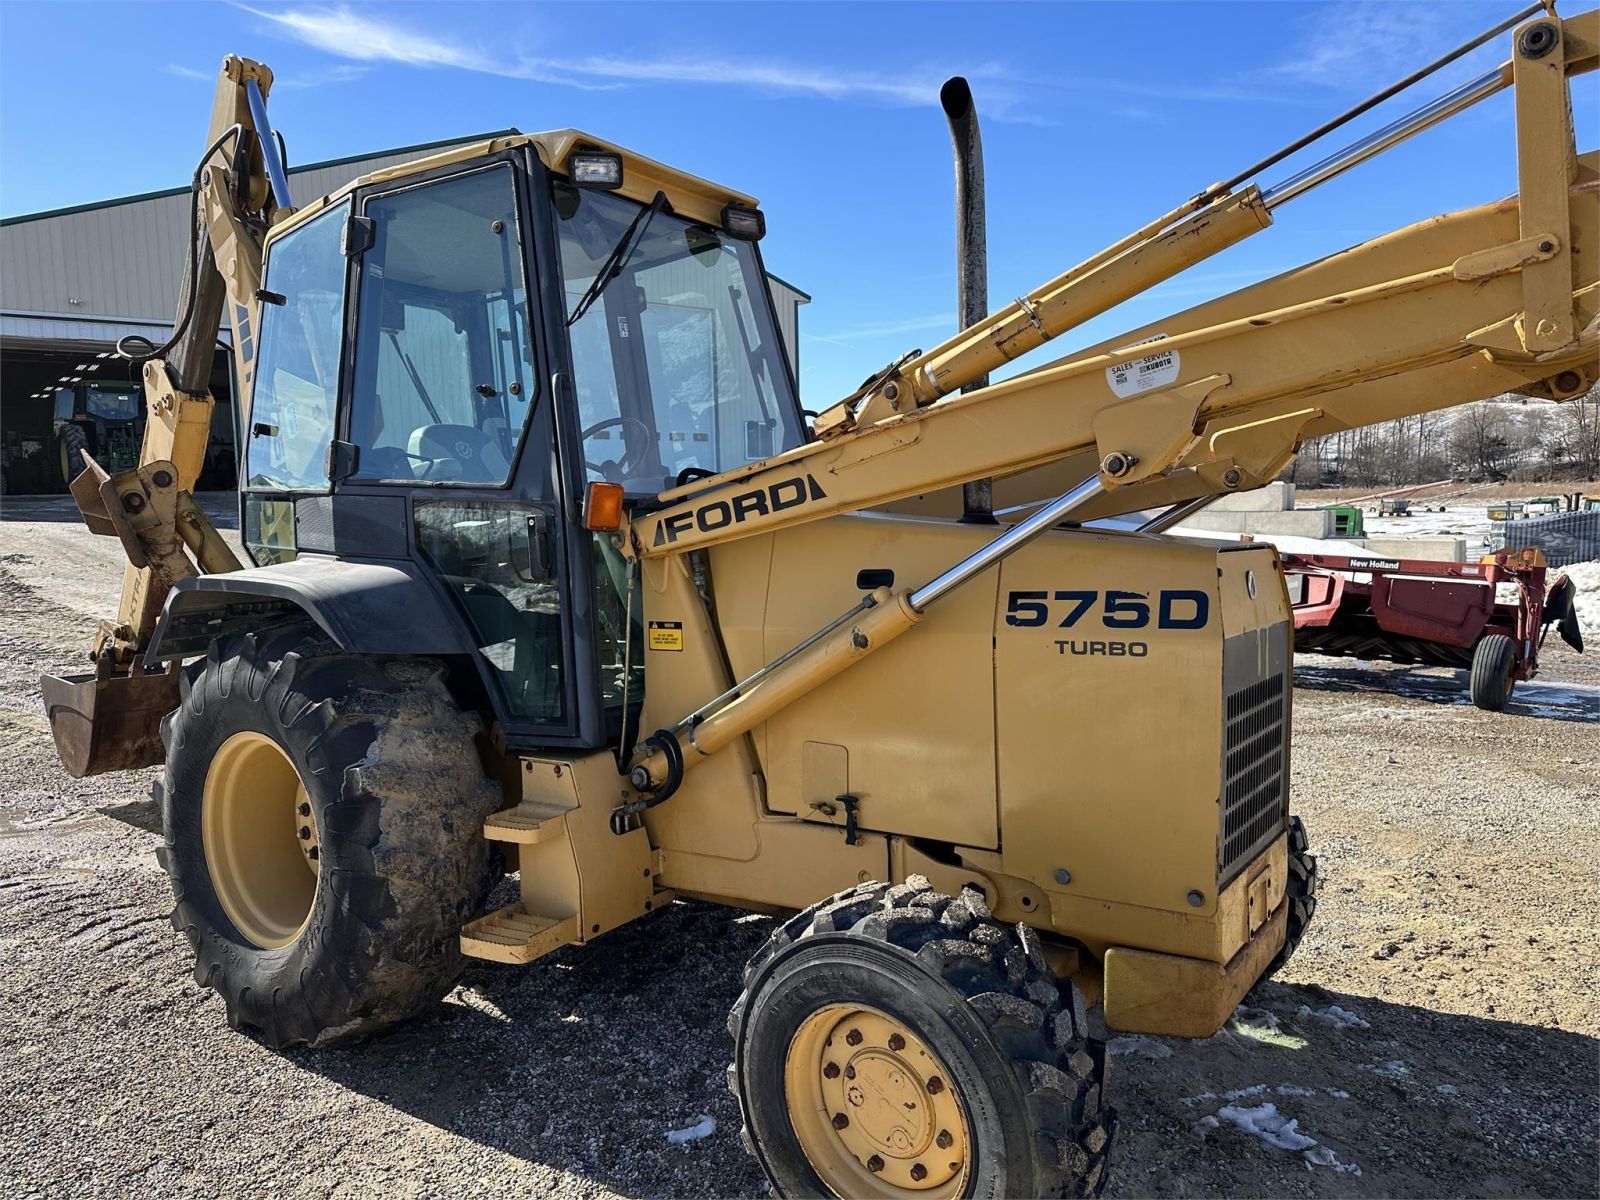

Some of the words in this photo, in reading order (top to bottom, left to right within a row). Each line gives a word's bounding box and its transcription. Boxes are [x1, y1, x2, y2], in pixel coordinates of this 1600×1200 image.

[1112, 363, 1133, 375] SALES
[1143, 351, 1173, 364] SERVICE
[1145, 358, 1172, 371] KUBOTA
[664, 477, 807, 543] FORD
[1350, 559, 1368, 567] New
[1369, 560, 1399, 569] Holland
[1005, 590, 1210, 630] 575D
[1054, 640, 1148, 657] TURBO
